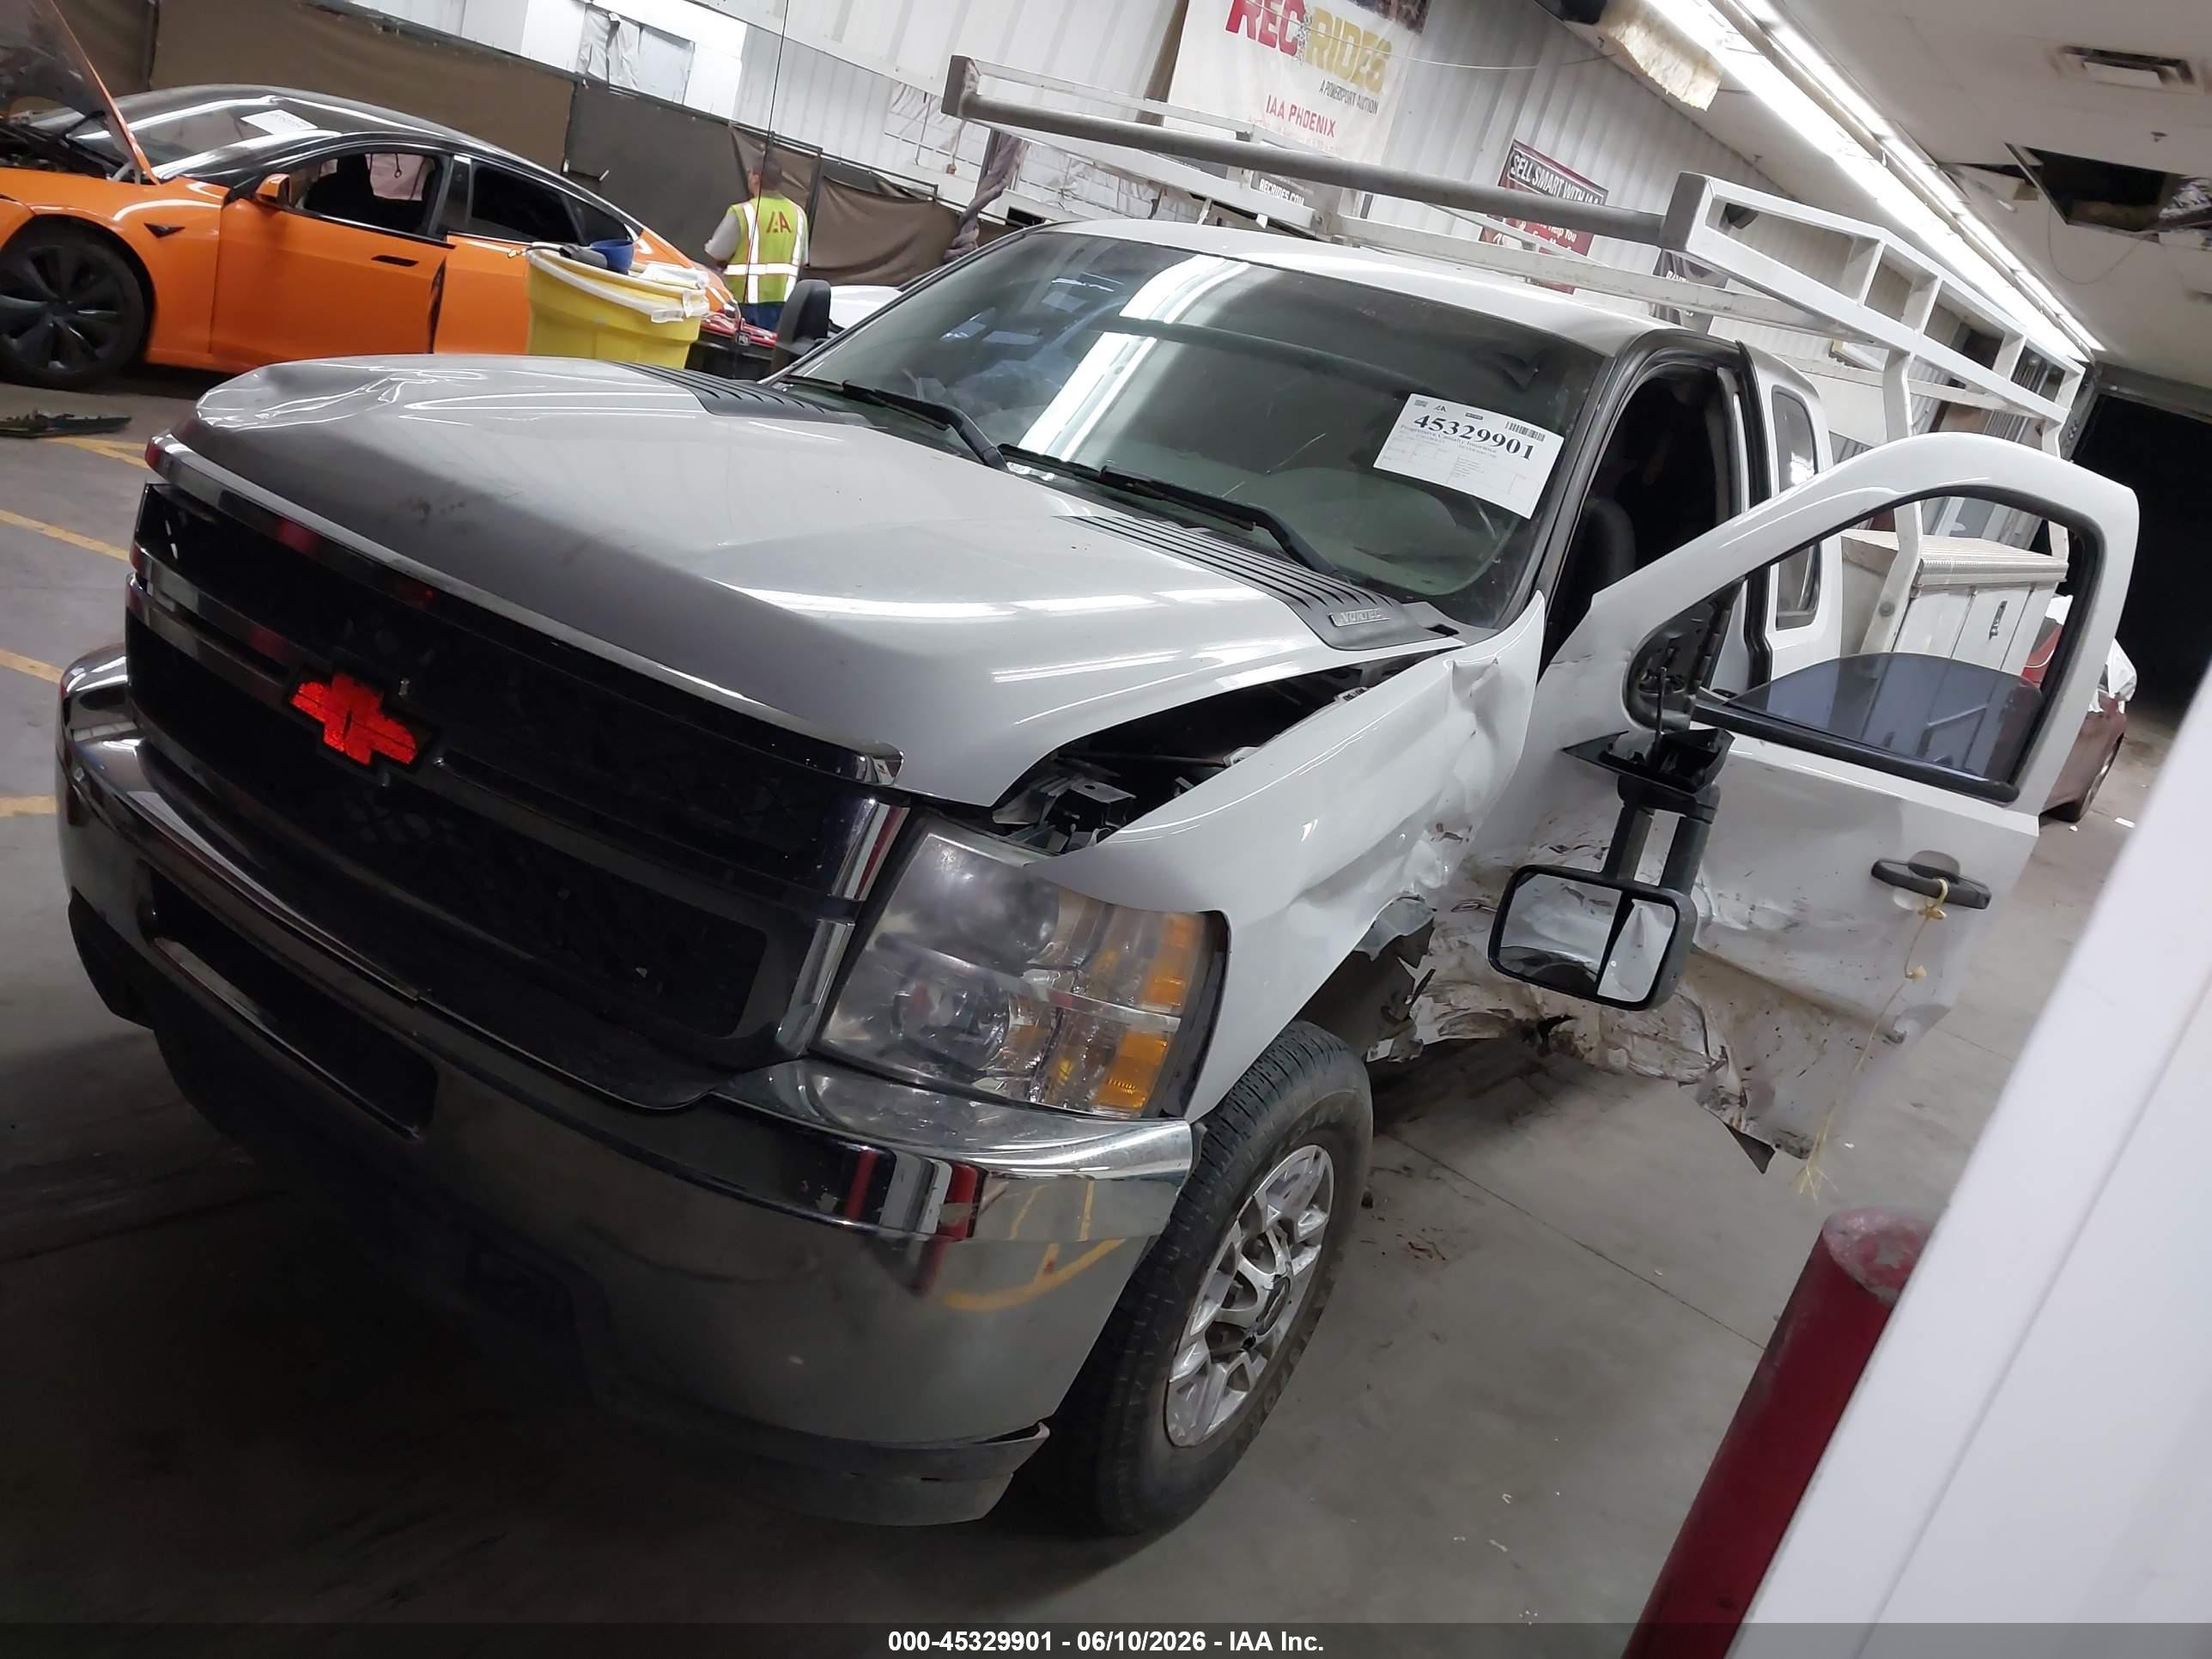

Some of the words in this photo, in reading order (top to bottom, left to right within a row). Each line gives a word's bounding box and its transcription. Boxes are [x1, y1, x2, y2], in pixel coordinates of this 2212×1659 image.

[1225, 0, 1306, 57] REC
[1304, 6, 1392, 94] RIDES
[1266, 94, 1285, 119] IAA
[1288, 104, 1336, 137] PHOENIX
[1259, 178, 1305, 206] RECRIDESCOM
[1510, 155, 1534, 183] SELL
[1532, 167, 1565, 198] SMART
[1413, 415, 1534, 461] 45329901
